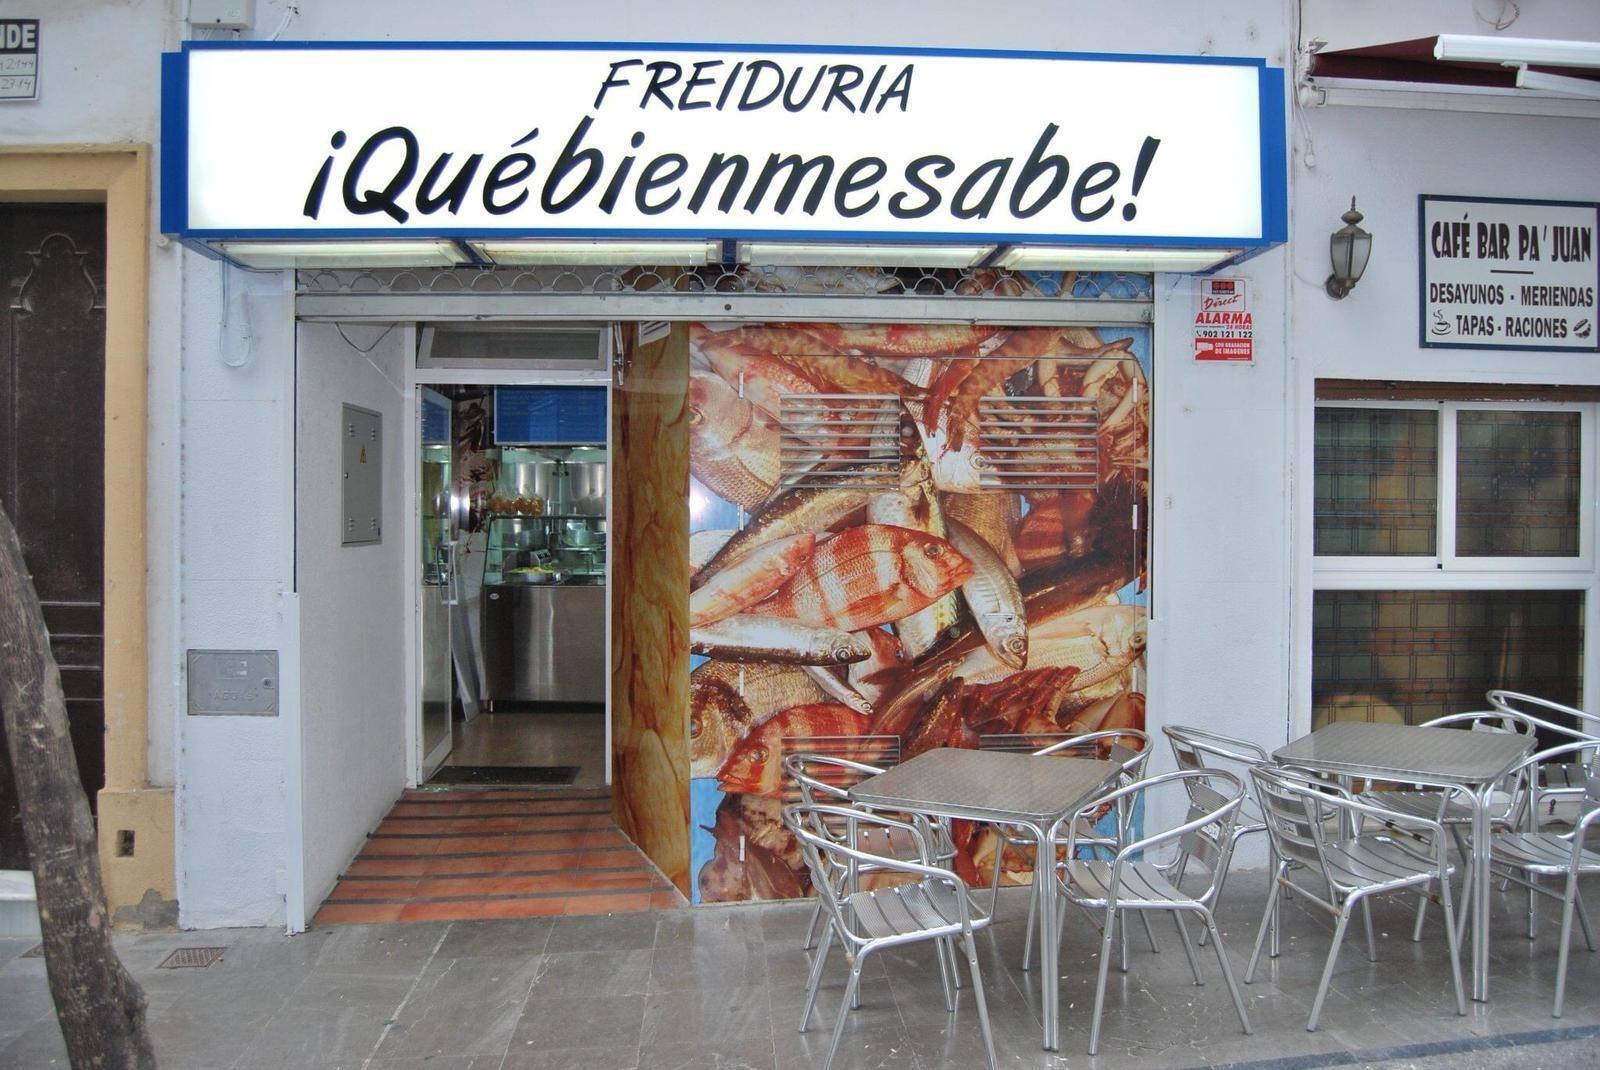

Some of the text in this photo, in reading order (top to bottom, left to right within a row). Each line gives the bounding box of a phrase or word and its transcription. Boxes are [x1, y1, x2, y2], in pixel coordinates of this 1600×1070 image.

[594, 59, 913, 113] FREIDURIA
[304, 116, 1160, 224] ¡Québienmesabe!
[1431, 212, 1470, 258] CAFÉ
[1477, 222, 1510, 261] BAR
[1552, 226, 1591, 262] JUAN
[1430, 283, 1593, 307] DESAYUNOS MERIENDAS
[1195, 312, 1252, 324] ALARMA
[1456, 315, 1567, 338] TAPAS RACIONES
